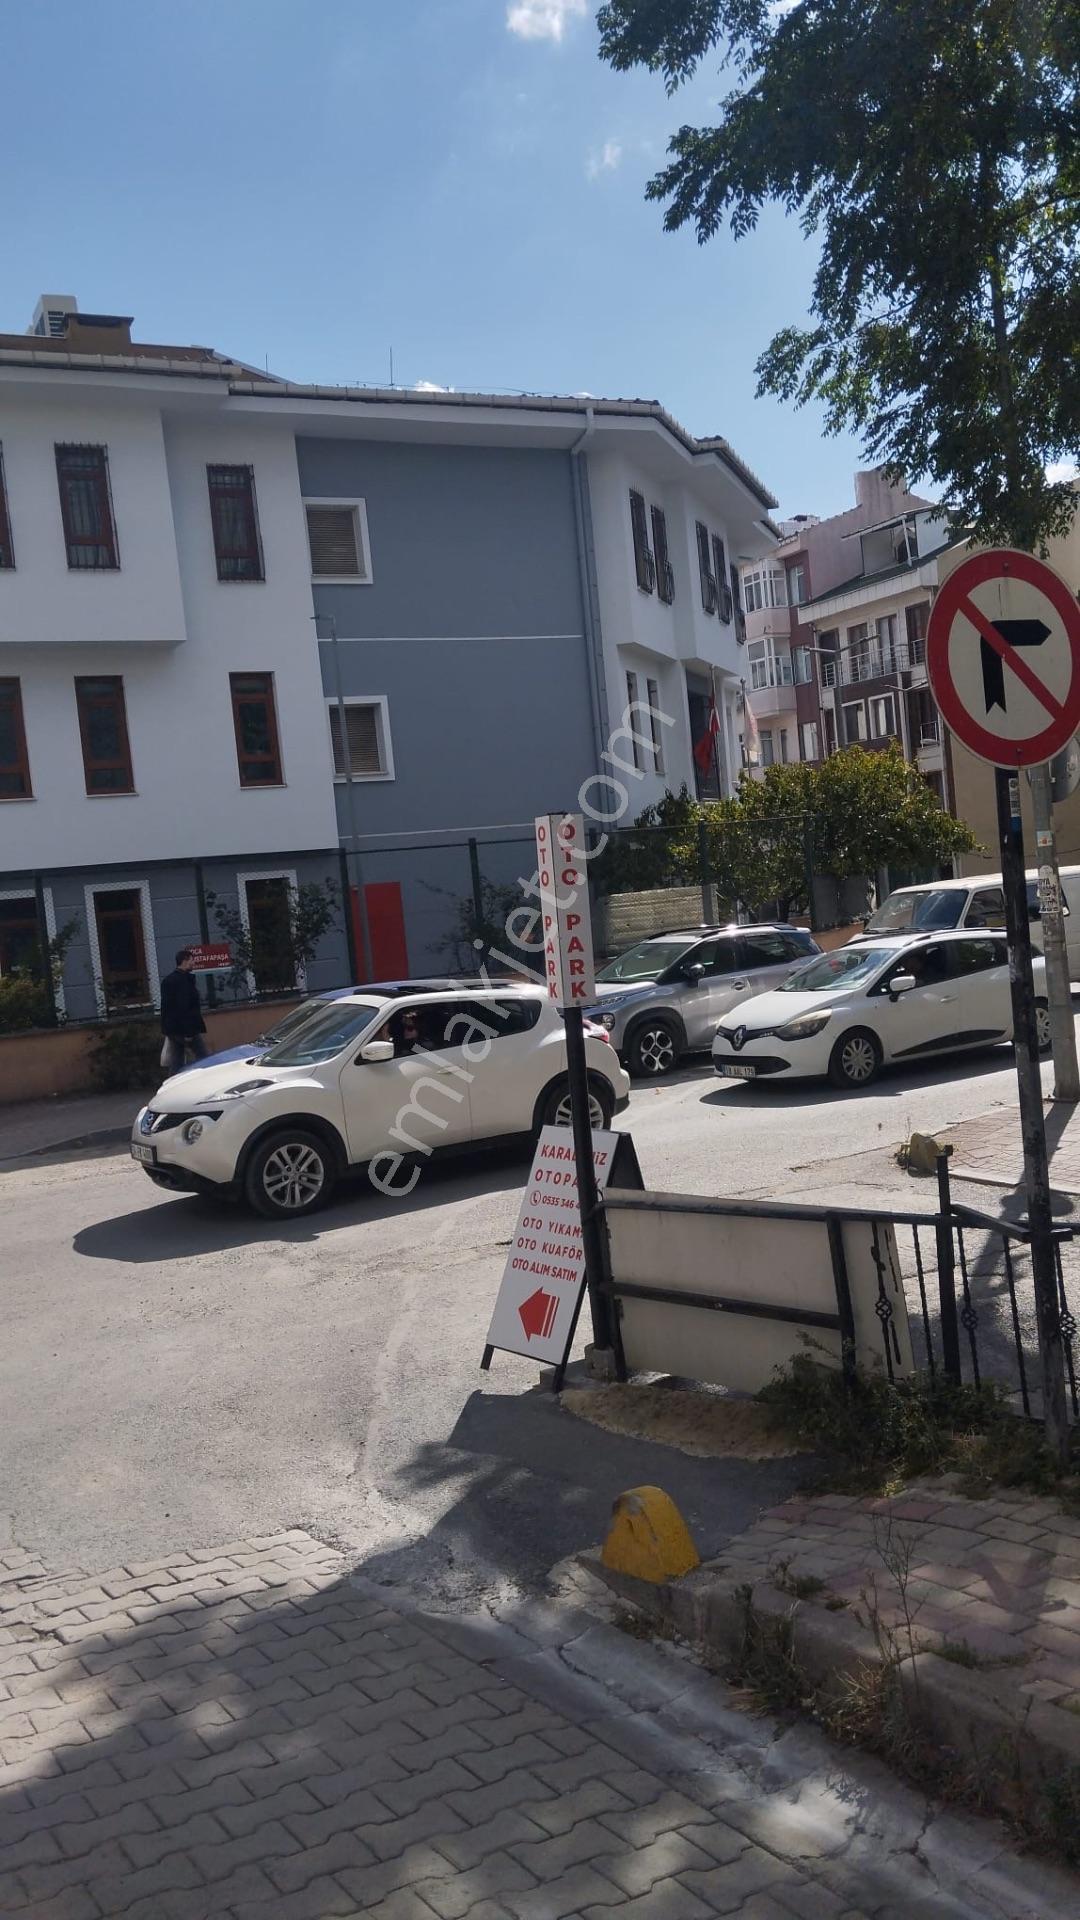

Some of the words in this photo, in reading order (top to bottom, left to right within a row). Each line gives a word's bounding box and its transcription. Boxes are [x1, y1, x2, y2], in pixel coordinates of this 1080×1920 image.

[537, 825, 550, 887] OTO
[545, 915, 558, 999] PARK
[566, 914, 588, 999] PARK
[542, 1195, 560, 1207] 0535
[561, 1198, 575, 1209] 346
[523, 1217, 542, 1230] OTO
[517, 1237, 536, 1250] OTO
[542, 1242, 583, 1261] KUAFÖR
[512, 1258, 529, 1271] OTO
[530, 1261, 550, 1276] ALIM
[551, 1266, 577, 1282] SATIM
